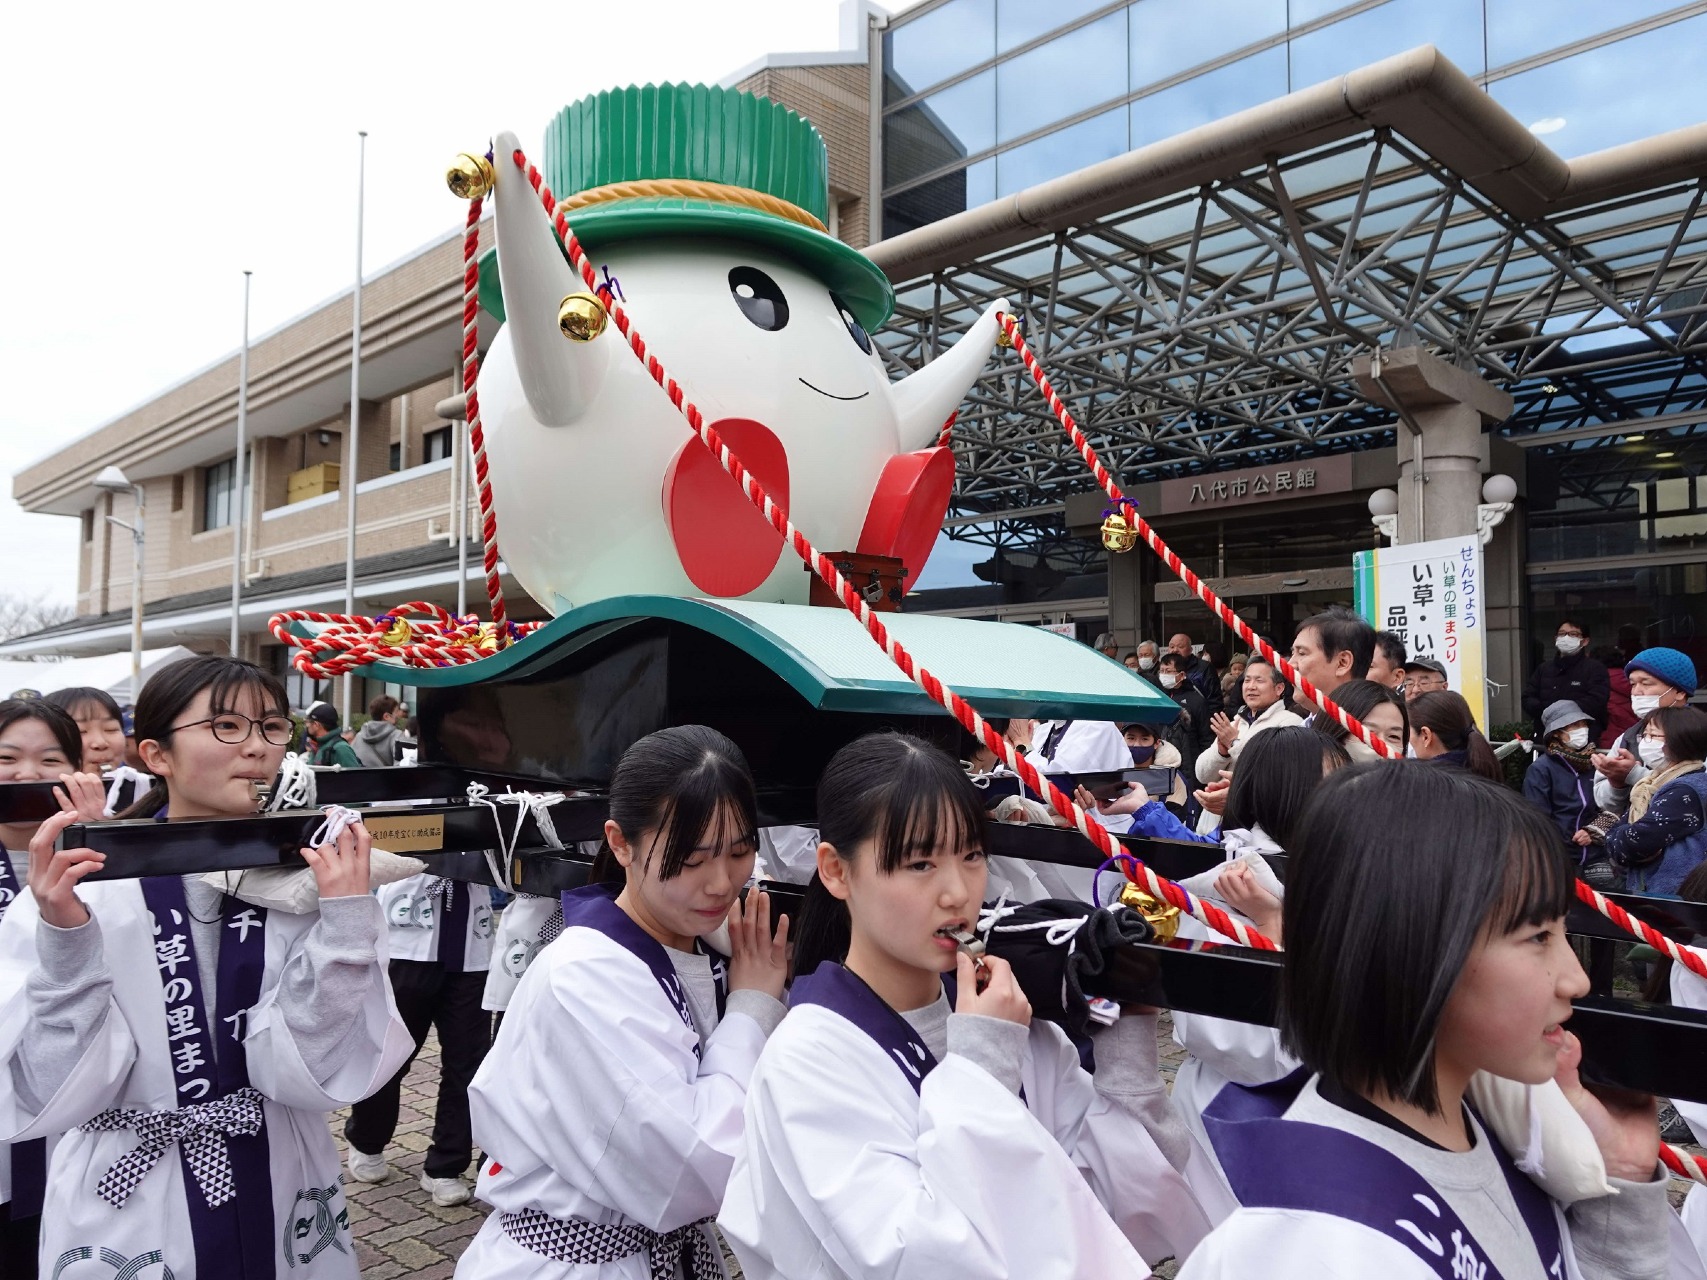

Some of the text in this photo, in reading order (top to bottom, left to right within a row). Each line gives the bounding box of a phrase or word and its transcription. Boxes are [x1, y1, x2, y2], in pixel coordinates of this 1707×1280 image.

[1189, 468, 1317, 503] 八代市公民館
[1443, 561, 1457, 663] い草の里まつり
[1461, 545, 1475, 628] せんちょう
